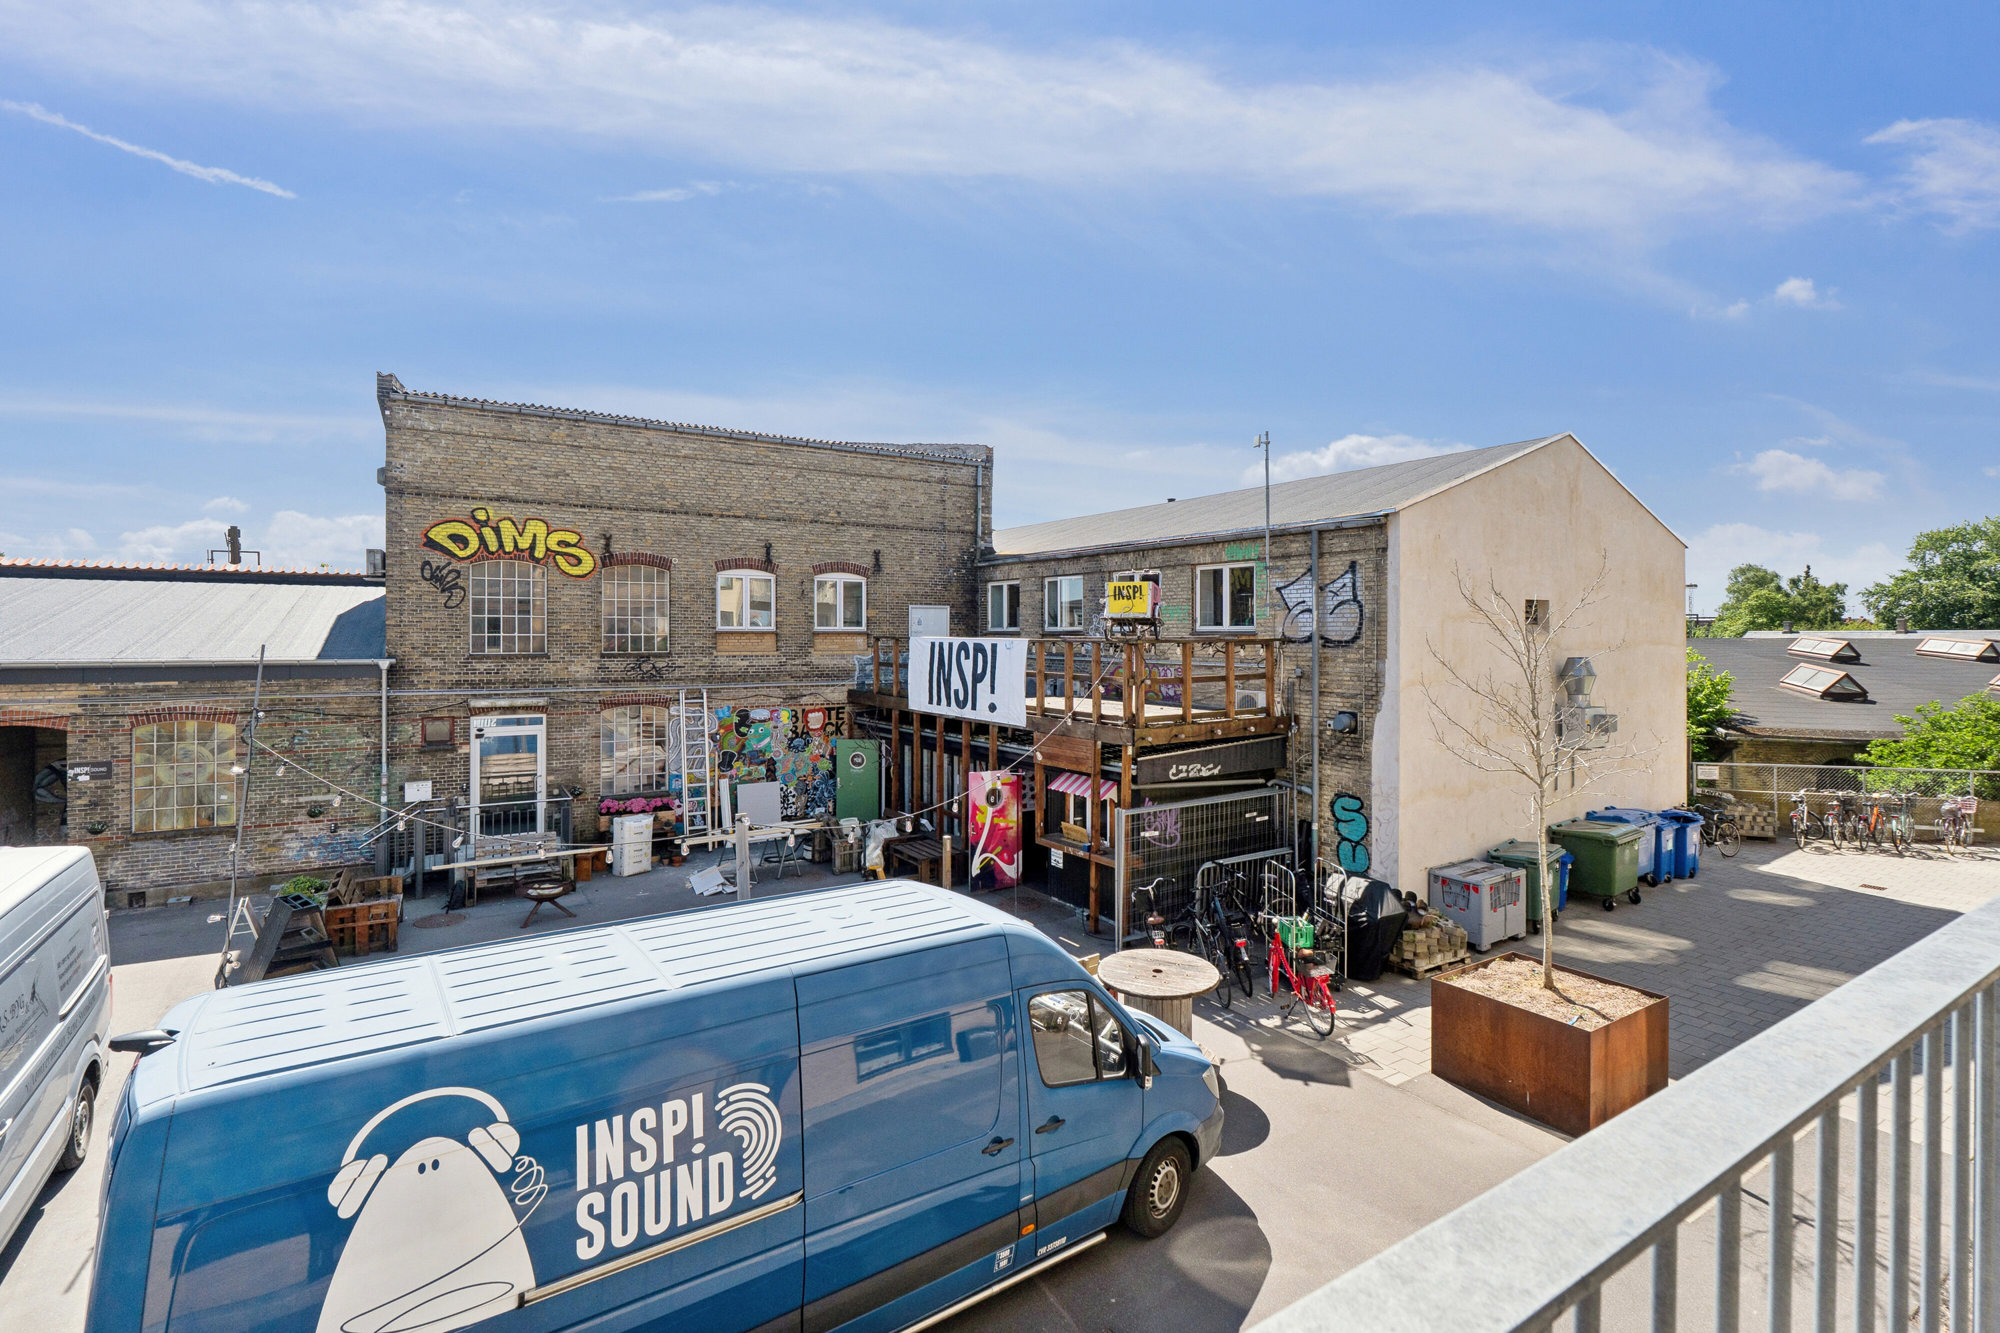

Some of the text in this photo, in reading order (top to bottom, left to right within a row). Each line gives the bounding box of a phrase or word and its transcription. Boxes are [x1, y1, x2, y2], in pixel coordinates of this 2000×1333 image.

[1113, 584, 1143, 601] INSP!
[927, 641, 998, 714] INSP!
[576, 1092, 706, 1192] INSP!
[576, 1151, 734, 1260] SOUND
